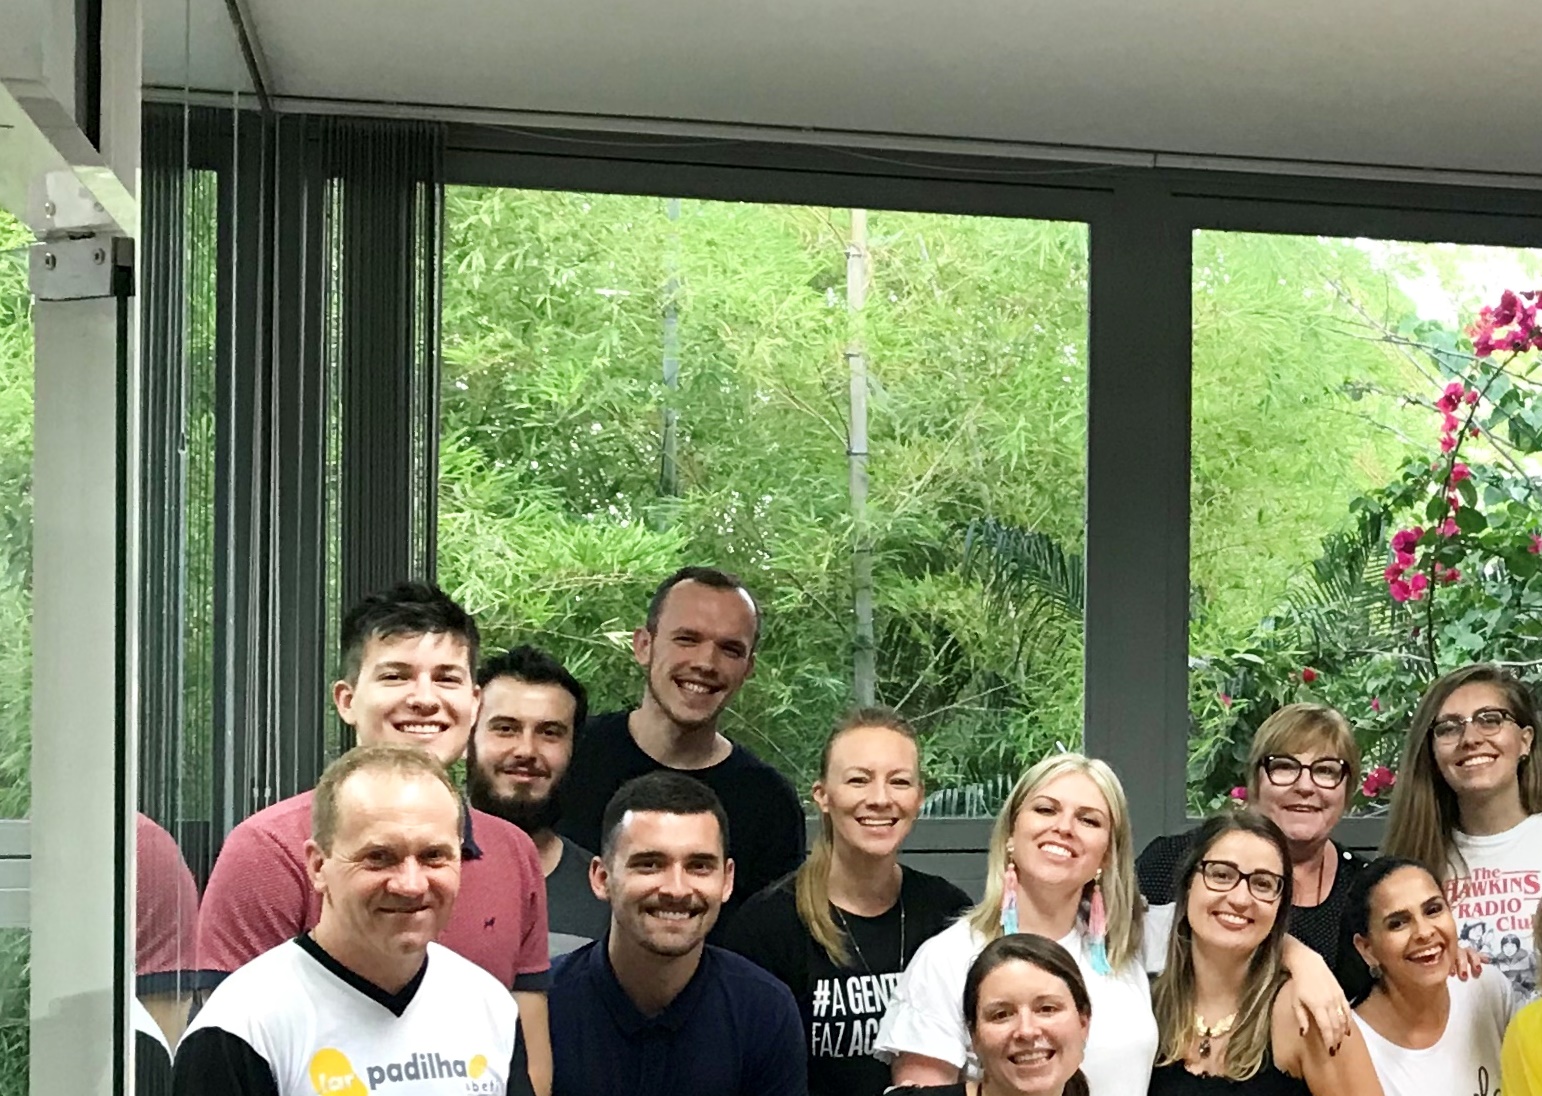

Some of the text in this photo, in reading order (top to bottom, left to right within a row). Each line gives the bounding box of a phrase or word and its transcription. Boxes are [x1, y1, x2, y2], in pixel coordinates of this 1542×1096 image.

[1473, 867, 1500, 881] The
[1458, 898, 1522, 919] RADIO
[1496, 915, 1534, 932] Clu
[811, 1021, 846, 1058] FAZ
[366, 1052, 468, 1091] padilha
